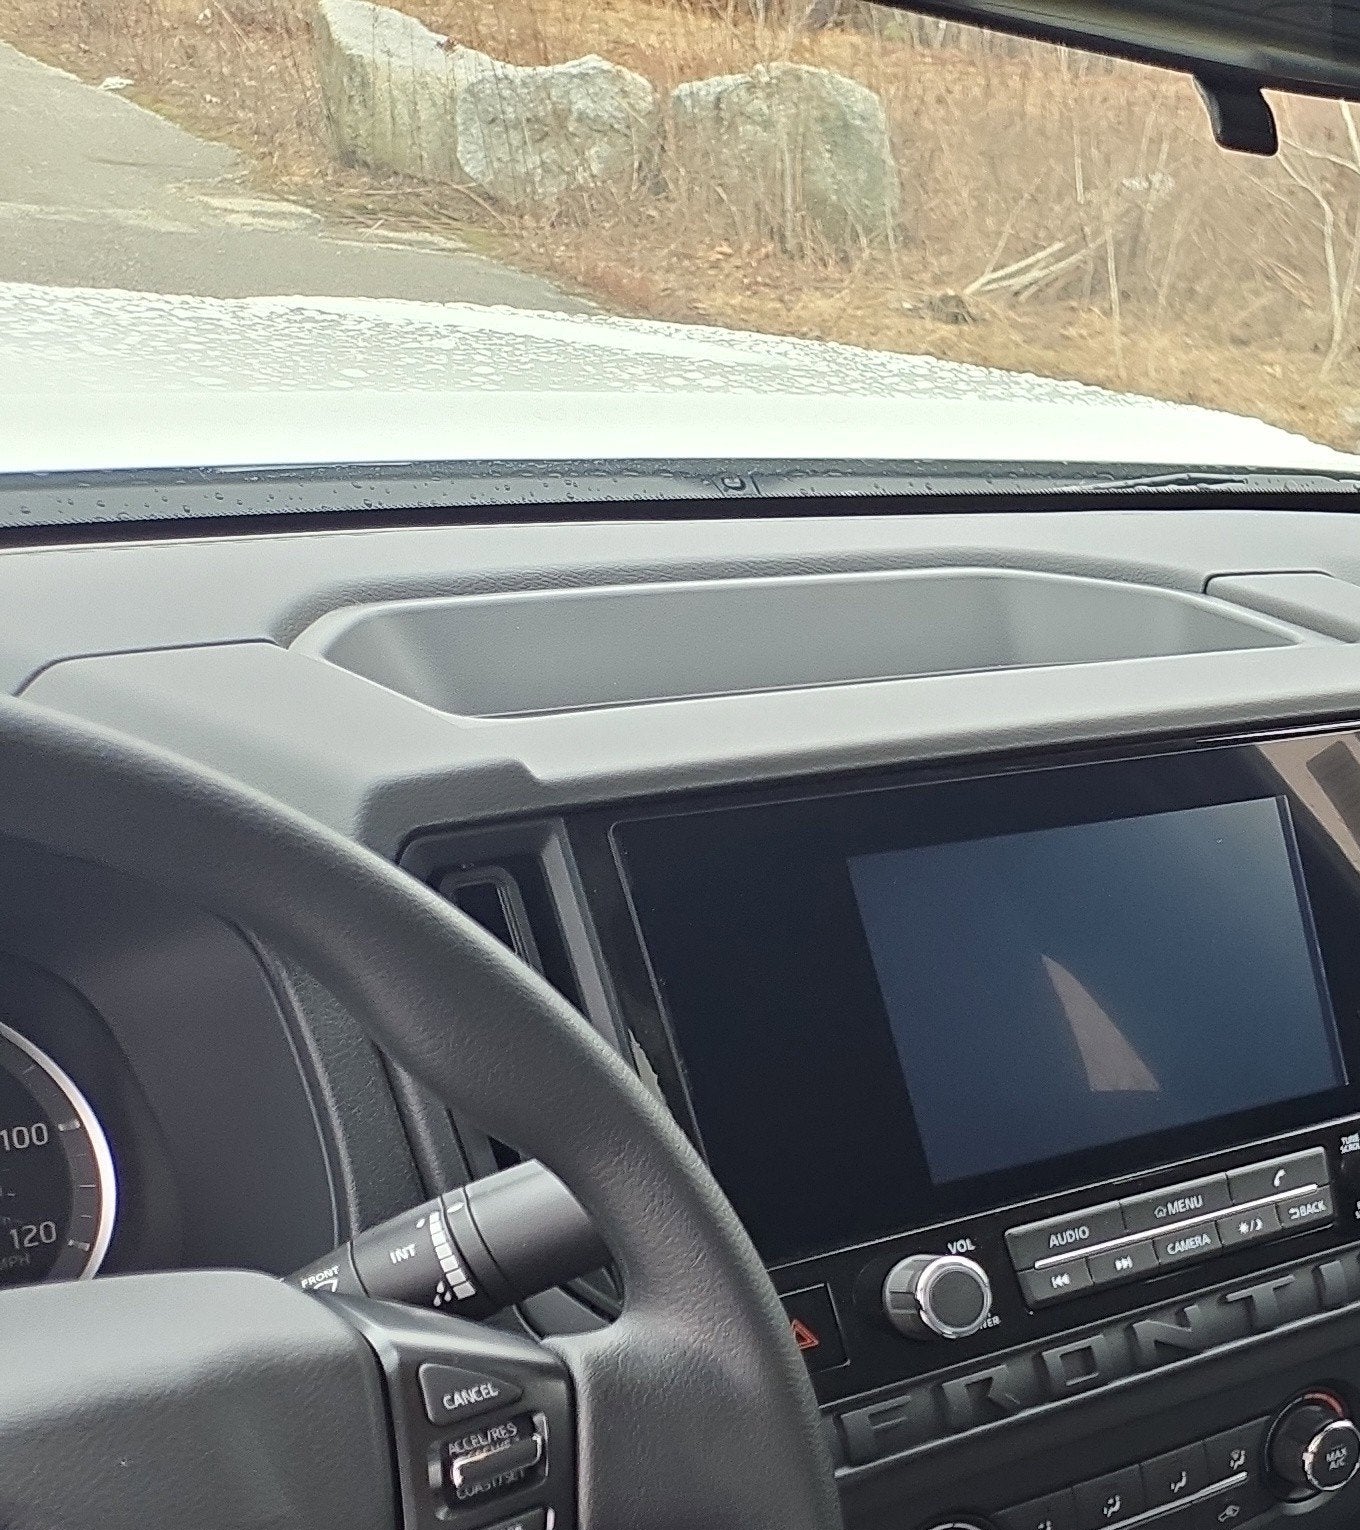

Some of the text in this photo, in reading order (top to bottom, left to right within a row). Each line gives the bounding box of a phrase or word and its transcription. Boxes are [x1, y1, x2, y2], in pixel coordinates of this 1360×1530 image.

[0, 1122, 48, 1151] 100
[1168, 1194, 1204, 1214] MENU
[1299, 1198, 1327, 1218] BACK
[10, 1220, 57, 1249] 120
[1048, 1225, 1090, 1249] AUDIO
[1166, 1233, 1212, 1256] CAMERA
[389, 1243, 416, 1264] INT
[947, 1241, 976, 1255] VOL
[301, 1264, 341, 1289] FRONT
[442, 1381, 500, 1411] CANCEL
[449, 1421, 519, 1456] ACCEL/RES
[1326, 1447, 1348, 1462] MAX
